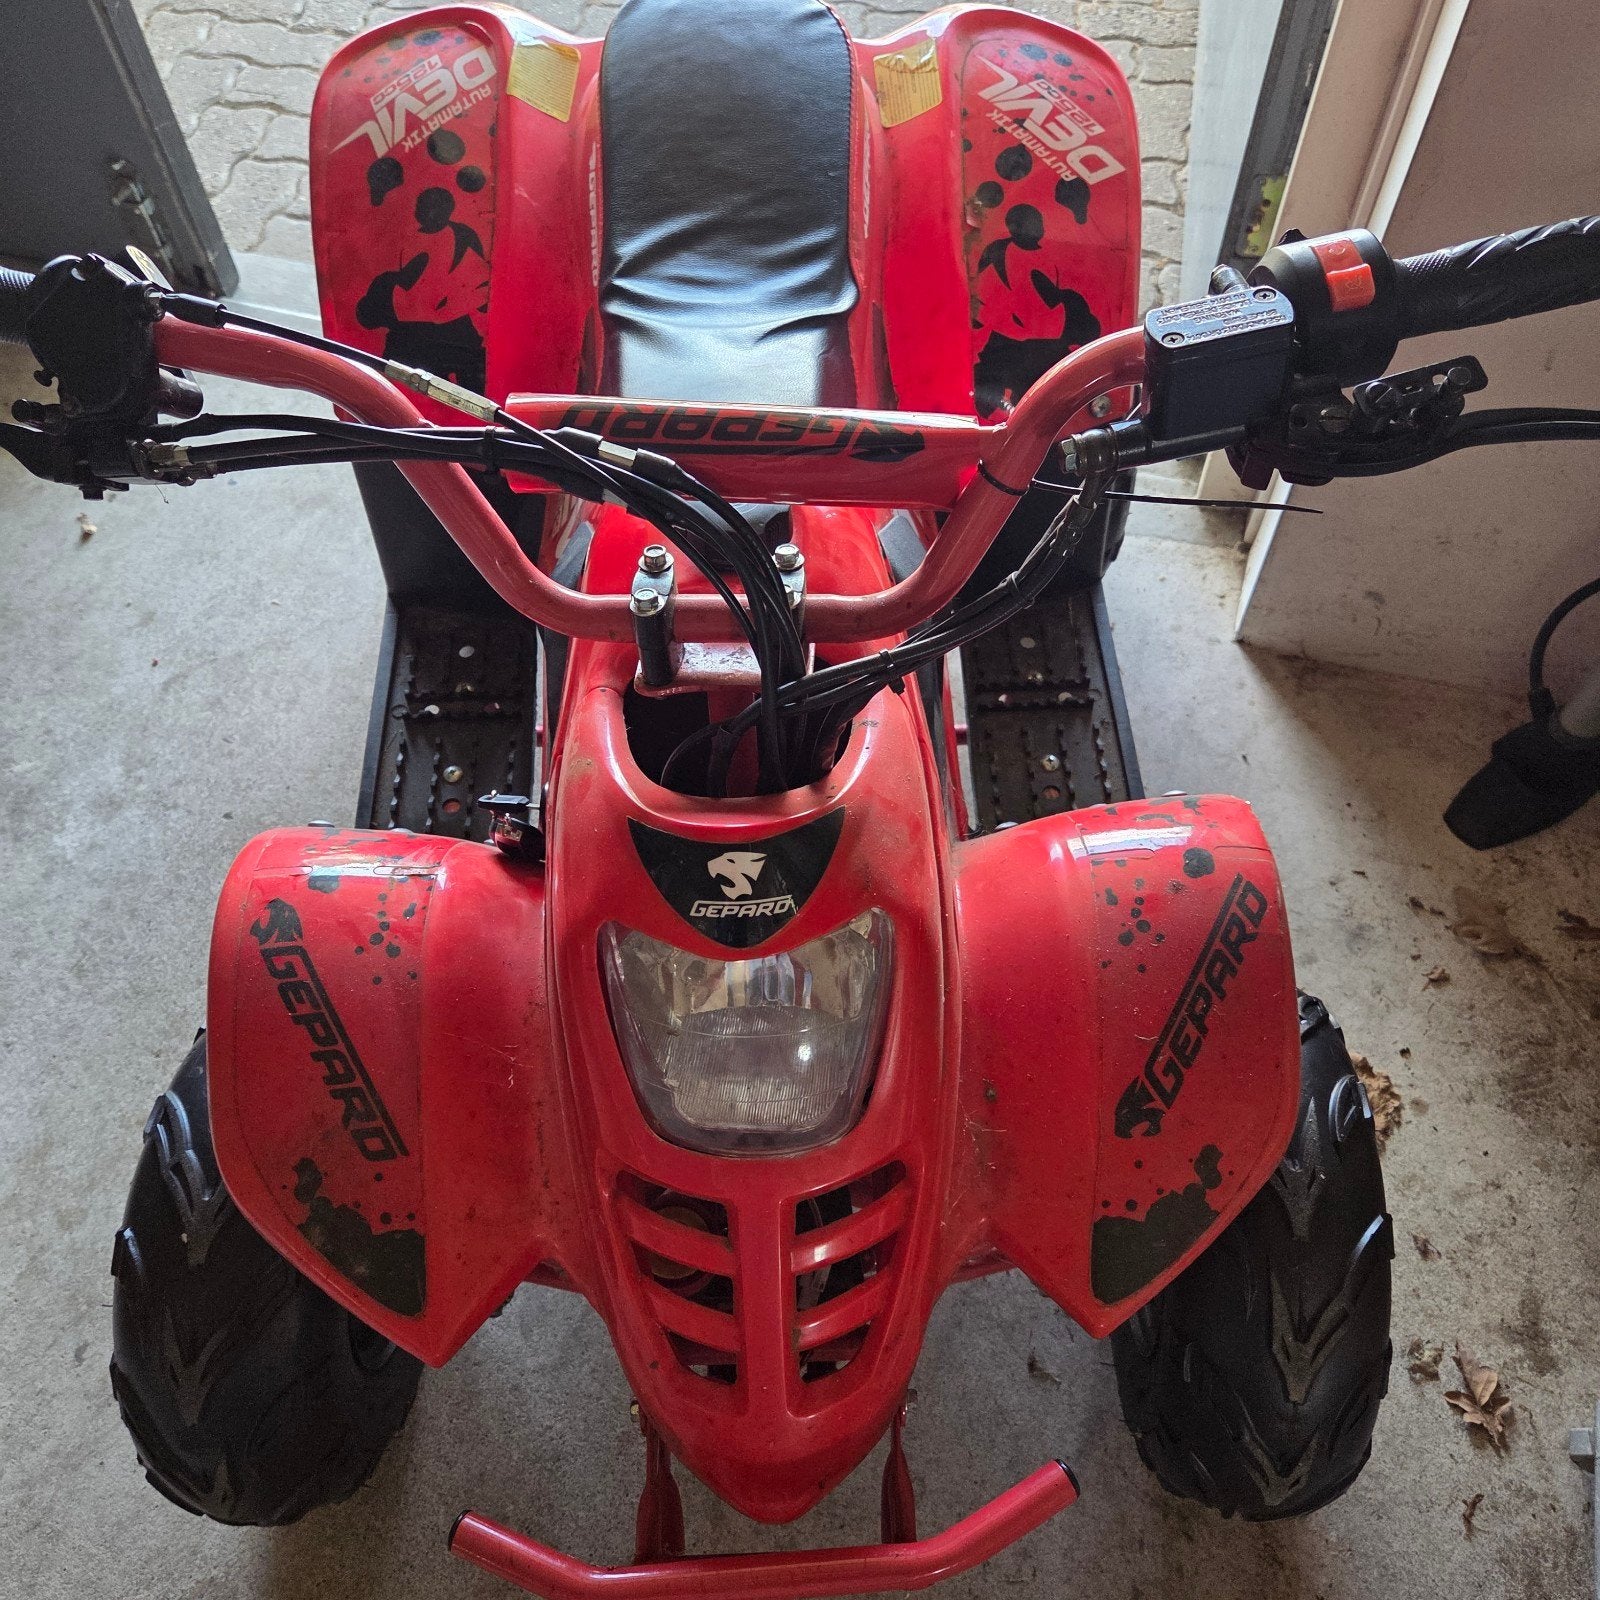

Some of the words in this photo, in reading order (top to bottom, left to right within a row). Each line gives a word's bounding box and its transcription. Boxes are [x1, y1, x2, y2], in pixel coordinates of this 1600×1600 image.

[328, 45, 497, 158] DEVIL
[975, 54, 1126, 185] DEVIL
[690, 895, 792, 918] GEPARD
[262, 946, 409, 1162] GEPARD
[1143, 873, 1268, 1110] GEPARD
